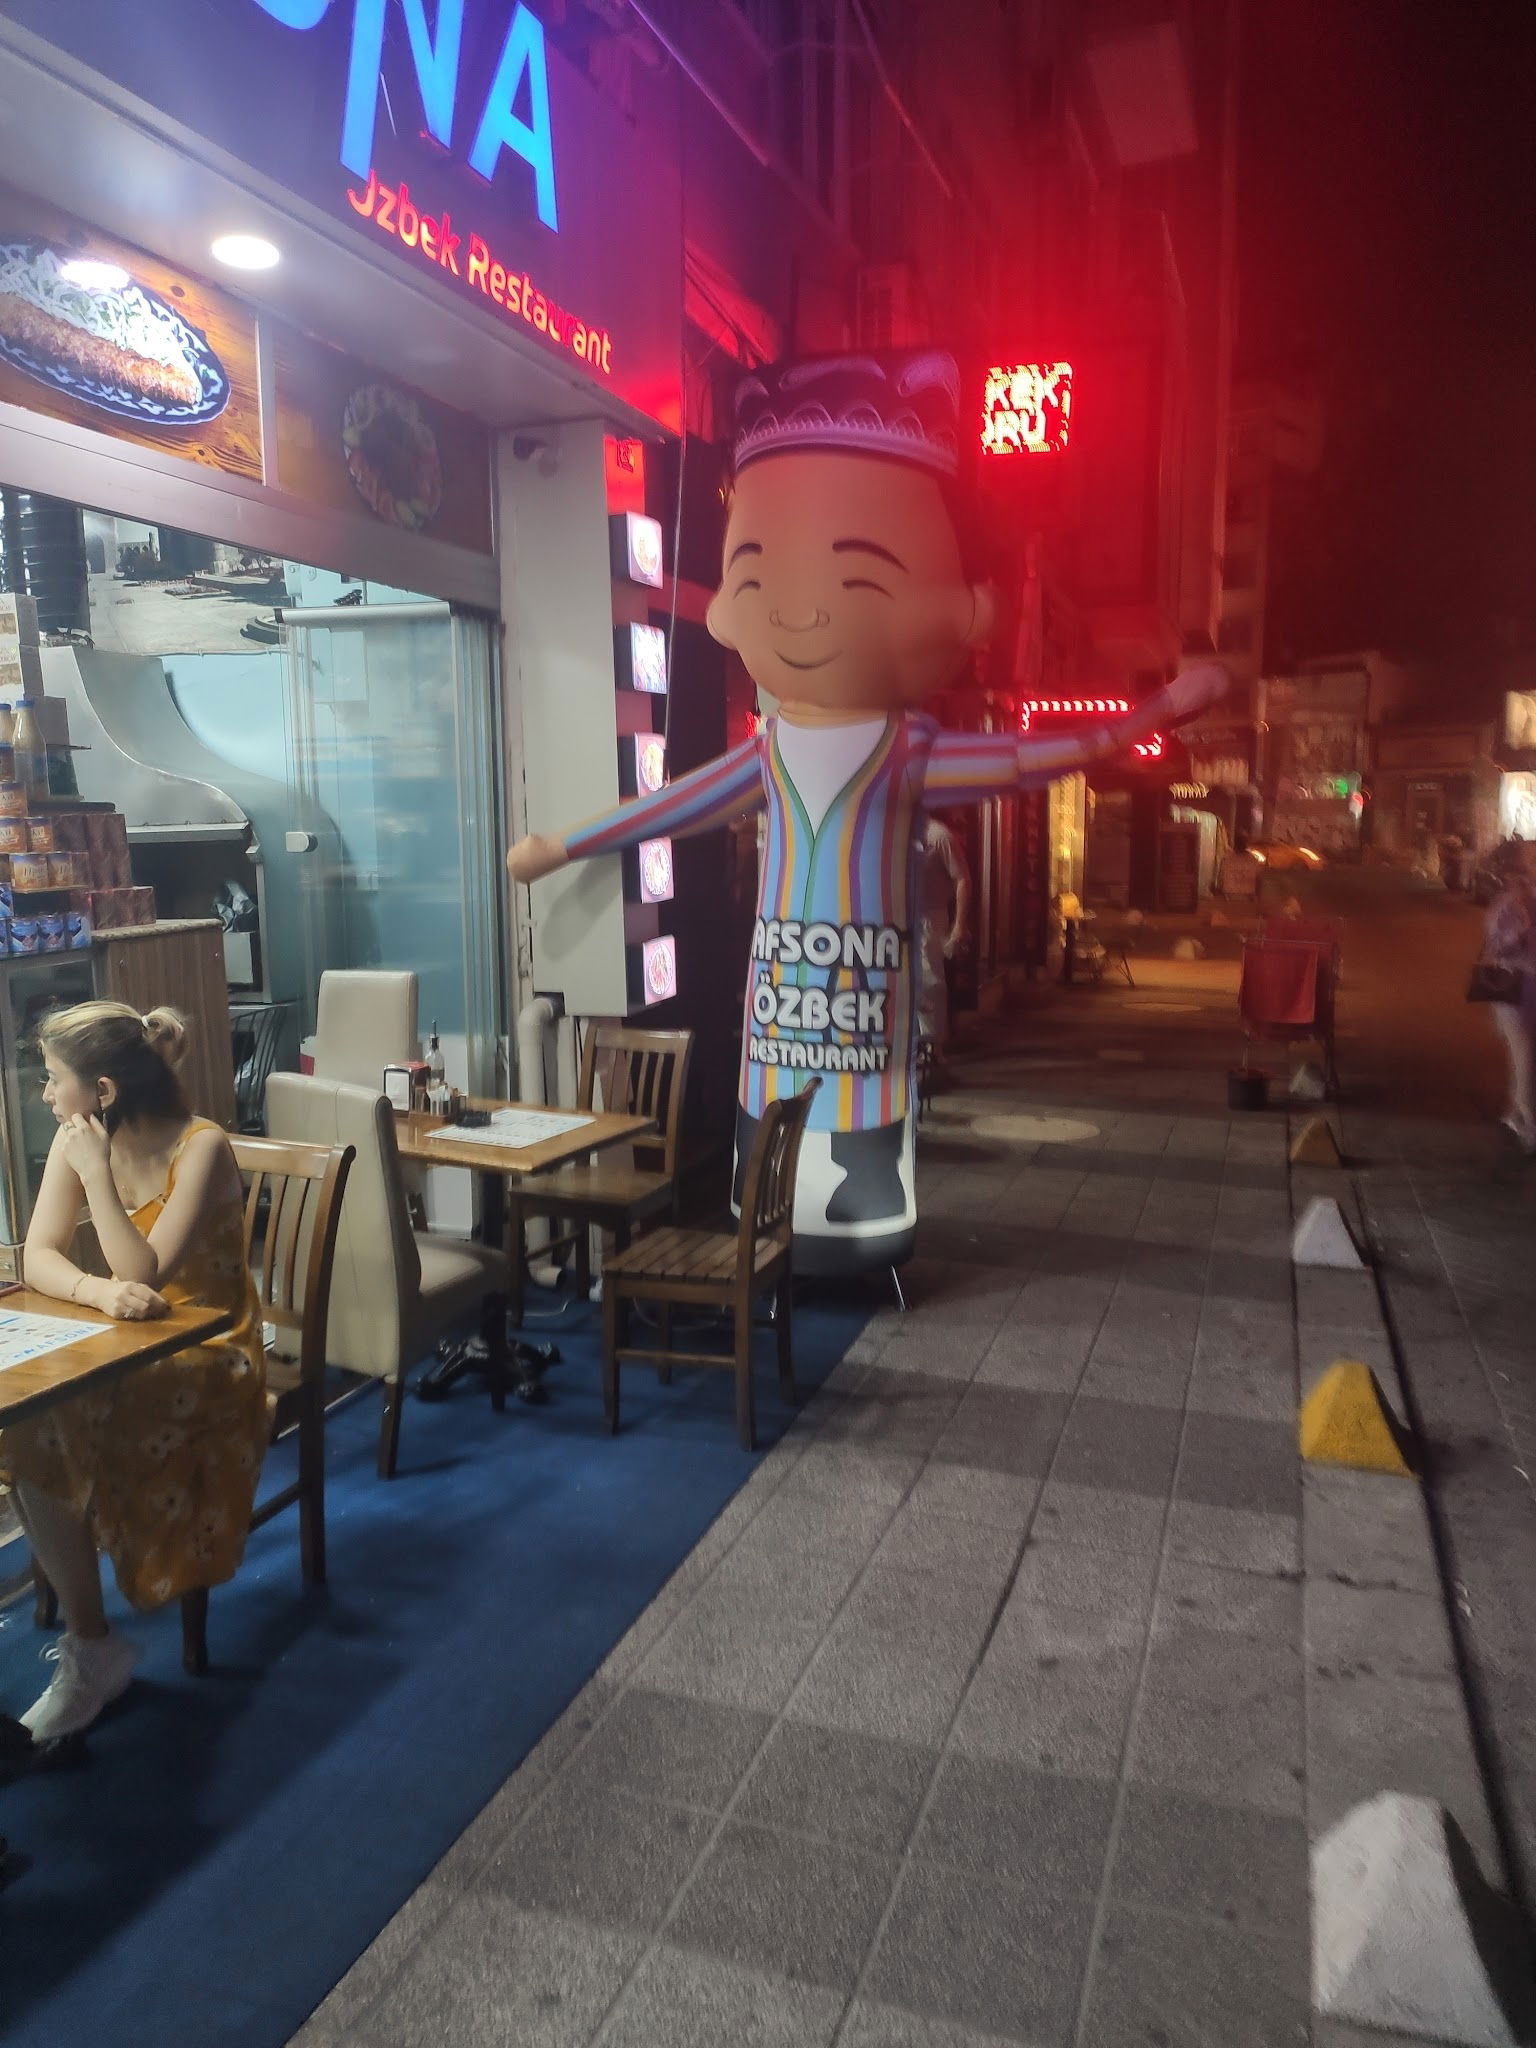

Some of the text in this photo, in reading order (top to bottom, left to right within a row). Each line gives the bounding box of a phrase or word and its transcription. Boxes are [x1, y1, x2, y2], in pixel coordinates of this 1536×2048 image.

[250, 0, 559, 234] NA
[466, 231, 613, 375] Restaurant
[752, 916, 901, 969] AFSONA
[753, 970, 887, 1033] ÖZBEK
[749, 1035, 889, 1071] RESTAURANT
